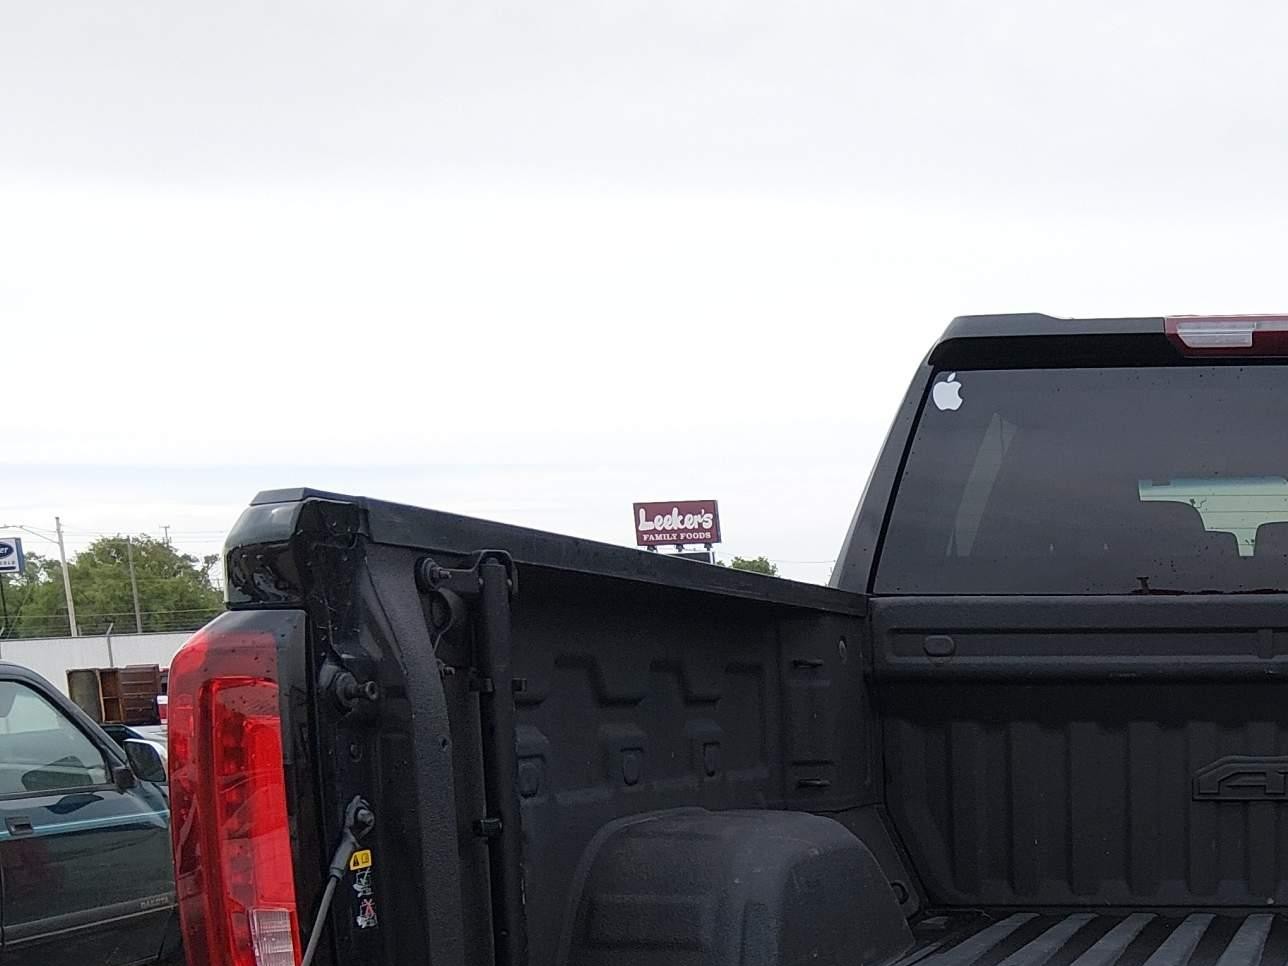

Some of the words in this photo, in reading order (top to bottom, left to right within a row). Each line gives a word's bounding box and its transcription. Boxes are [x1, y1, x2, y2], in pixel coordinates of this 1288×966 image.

[638, 507, 713, 531] Leeker's
[643, 533, 677, 541] FAMILY
[680, 532, 711, 540] FOODS
